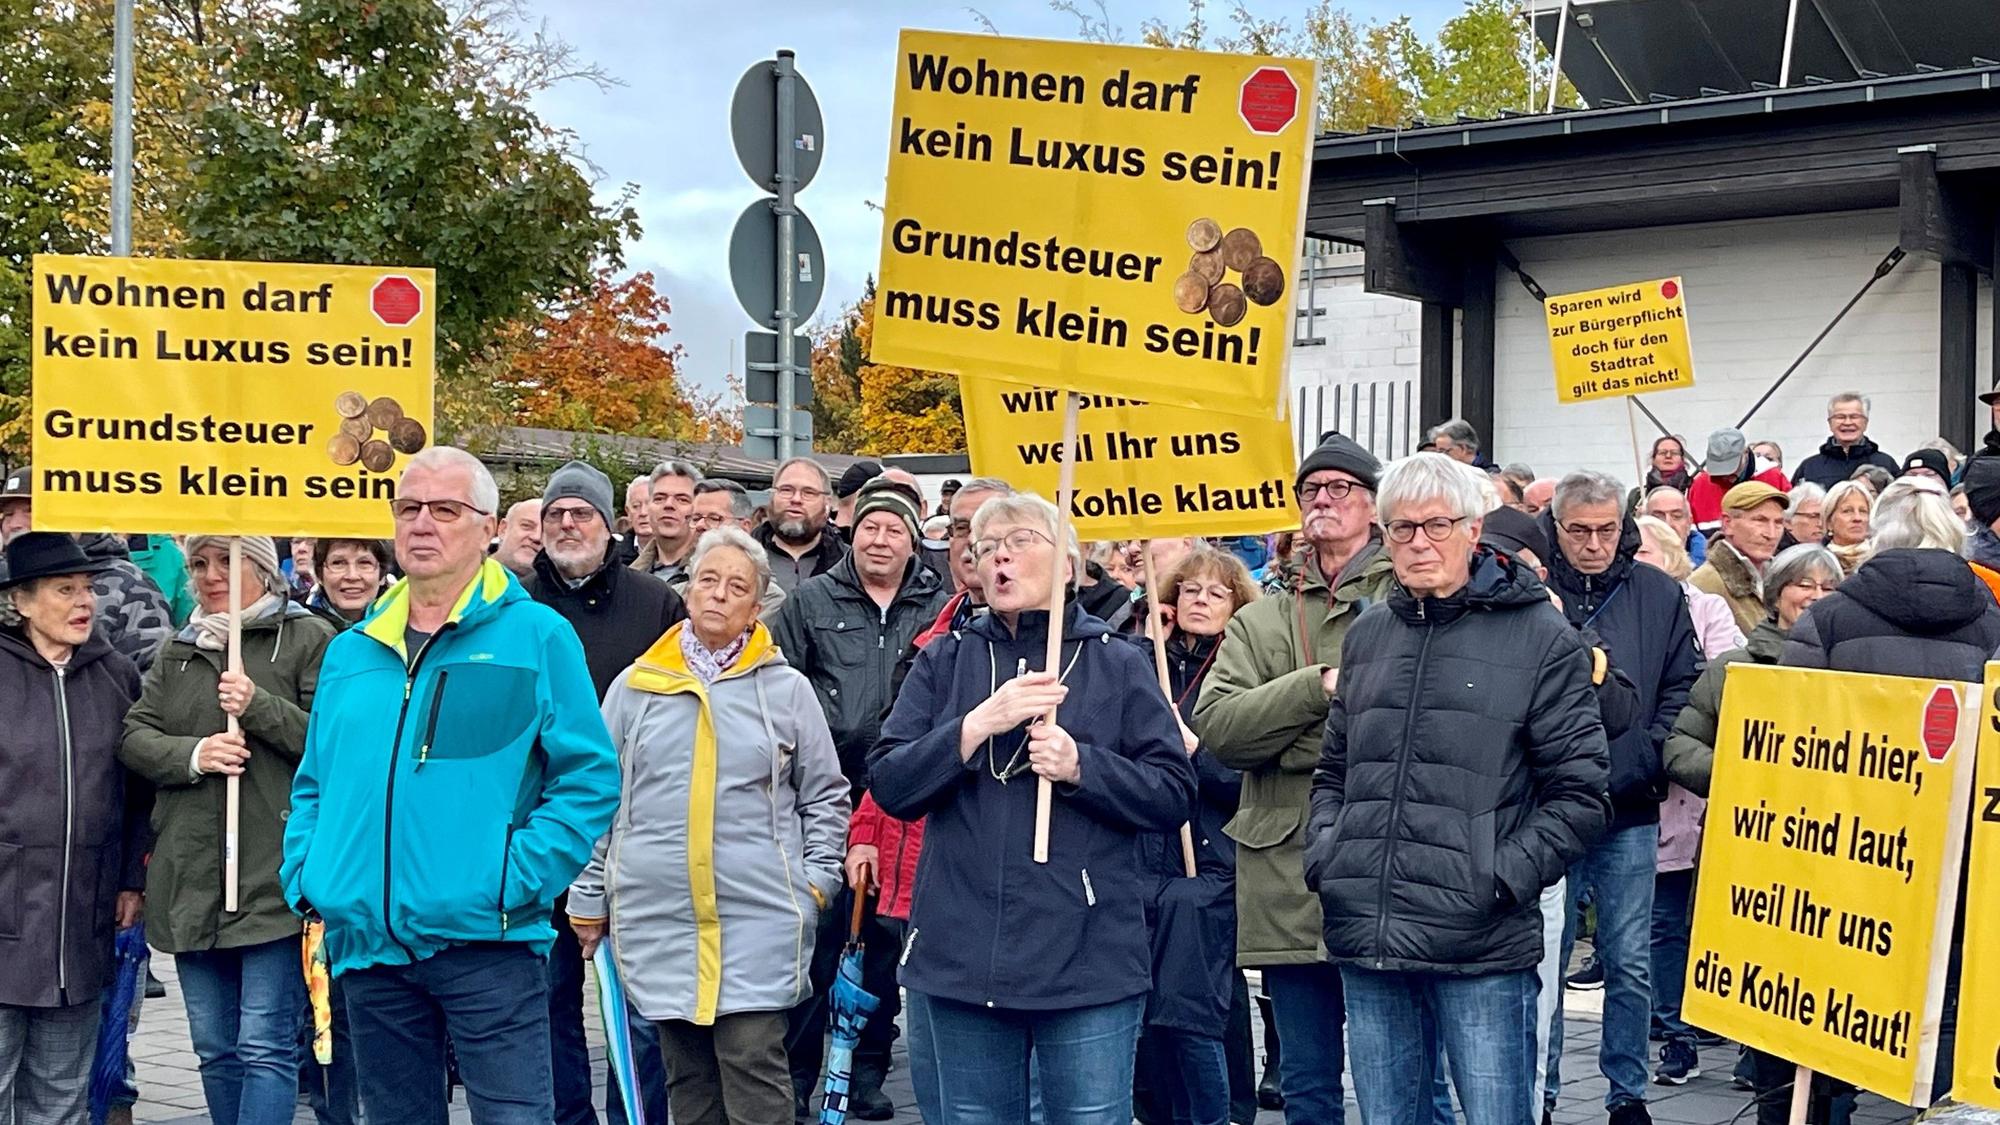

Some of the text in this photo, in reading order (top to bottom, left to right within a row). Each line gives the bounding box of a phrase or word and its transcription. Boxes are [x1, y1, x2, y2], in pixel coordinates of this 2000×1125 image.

[908, 52, 1201, 114] Wohnen darf
[899, 117, 1281, 191] kein Luxus sein!
[892, 218, 1162, 283] Grundsteuer
[46, 274, 333, 313] Wohnen darf
[1549, 289, 1641, 317] Sparen wird
[885, 290, 1261, 366] muss klein sein!
[1552, 306, 1683, 336] zur Bürgerpflicht
[45, 326, 412, 368] kein Luxus sein!
[1572, 333, 1668, 357] doch für den
[1590, 353, 1655, 373] Stadtrat
[1001, 386, 1058, 413] wir
[1573, 368, 1678, 398] gilt das nicht!
[45, 409, 314, 445] Grundsteuer
[1106, 431, 1158, 461] Ihr
[1171, 432, 1240, 457] uns
[44, 465, 404, 500] muss klein sein
[1174, 479, 1286, 513] klaut!
[1743, 719, 1922, 796] Wir sind hier,
[1734, 800, 1914, 884] wir sind laut,
[1731, 883, 1892, 957] weil Ihr uns
[1694, 950, 1911, 1059] die Kohle klaut!
